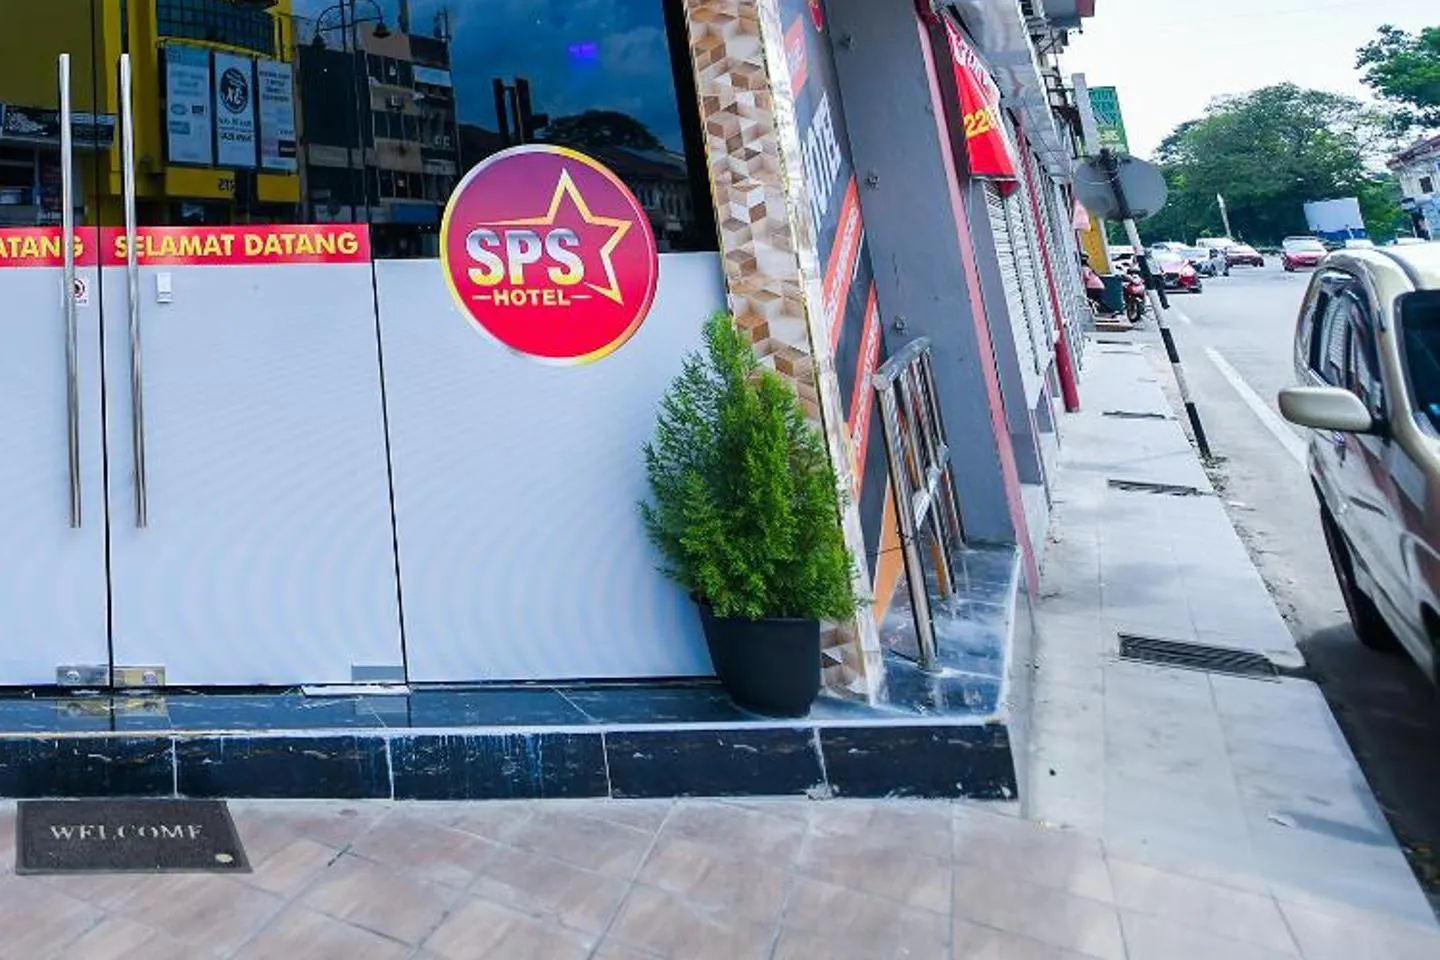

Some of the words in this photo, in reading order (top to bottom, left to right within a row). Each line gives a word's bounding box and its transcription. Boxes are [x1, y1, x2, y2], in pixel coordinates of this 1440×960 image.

[114, 233, 234, 258] SELAMAT
[244, 231, 359, 257] DATANG
[465, 227, 585, 287] SPS
[492, 288, 572, 307] HOTEL
[49, 823, 203, 840] WELCOME
